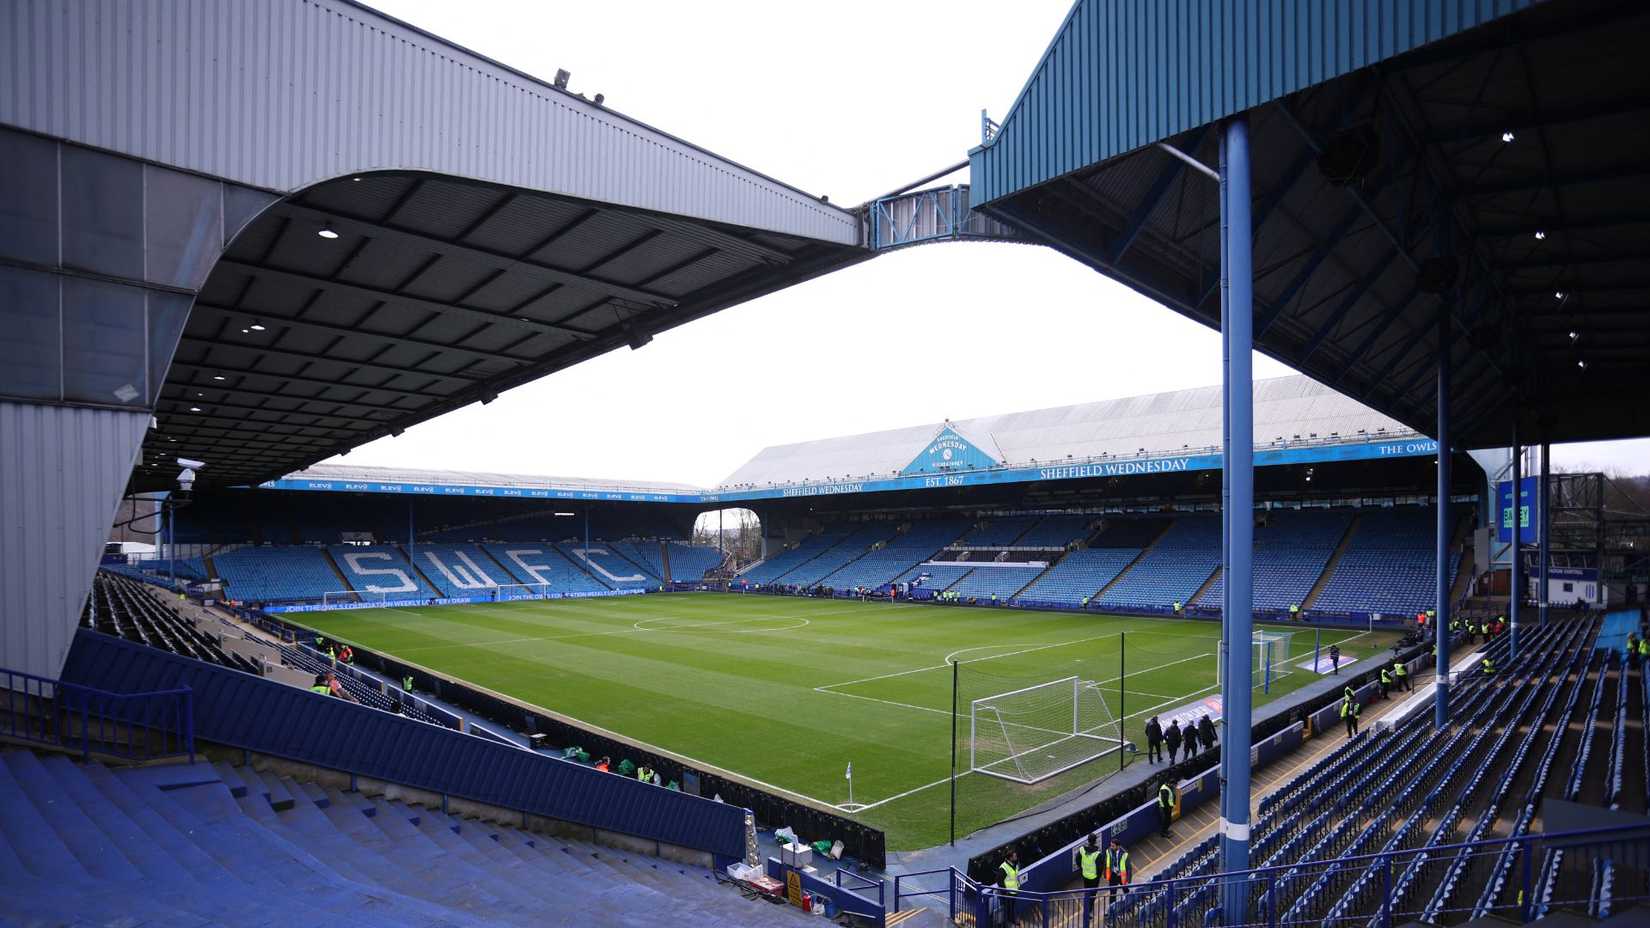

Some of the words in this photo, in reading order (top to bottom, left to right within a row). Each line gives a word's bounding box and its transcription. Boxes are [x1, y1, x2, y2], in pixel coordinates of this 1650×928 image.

[1379, 445, 1403, 455] THE
[1406, 441, 1438, 453] OWLS
[1040, 465, 1103, 480] SHEFFIELD
[1105, 458, 1190, 477] WEDNESDAY
[945, 476, 964, 487] 1867
[783, 487, 817, 497] SHEFFIELD
[819, 483, 863, 495] WEDNESDAY
[393, 600, 420, 608] WEEKLY
